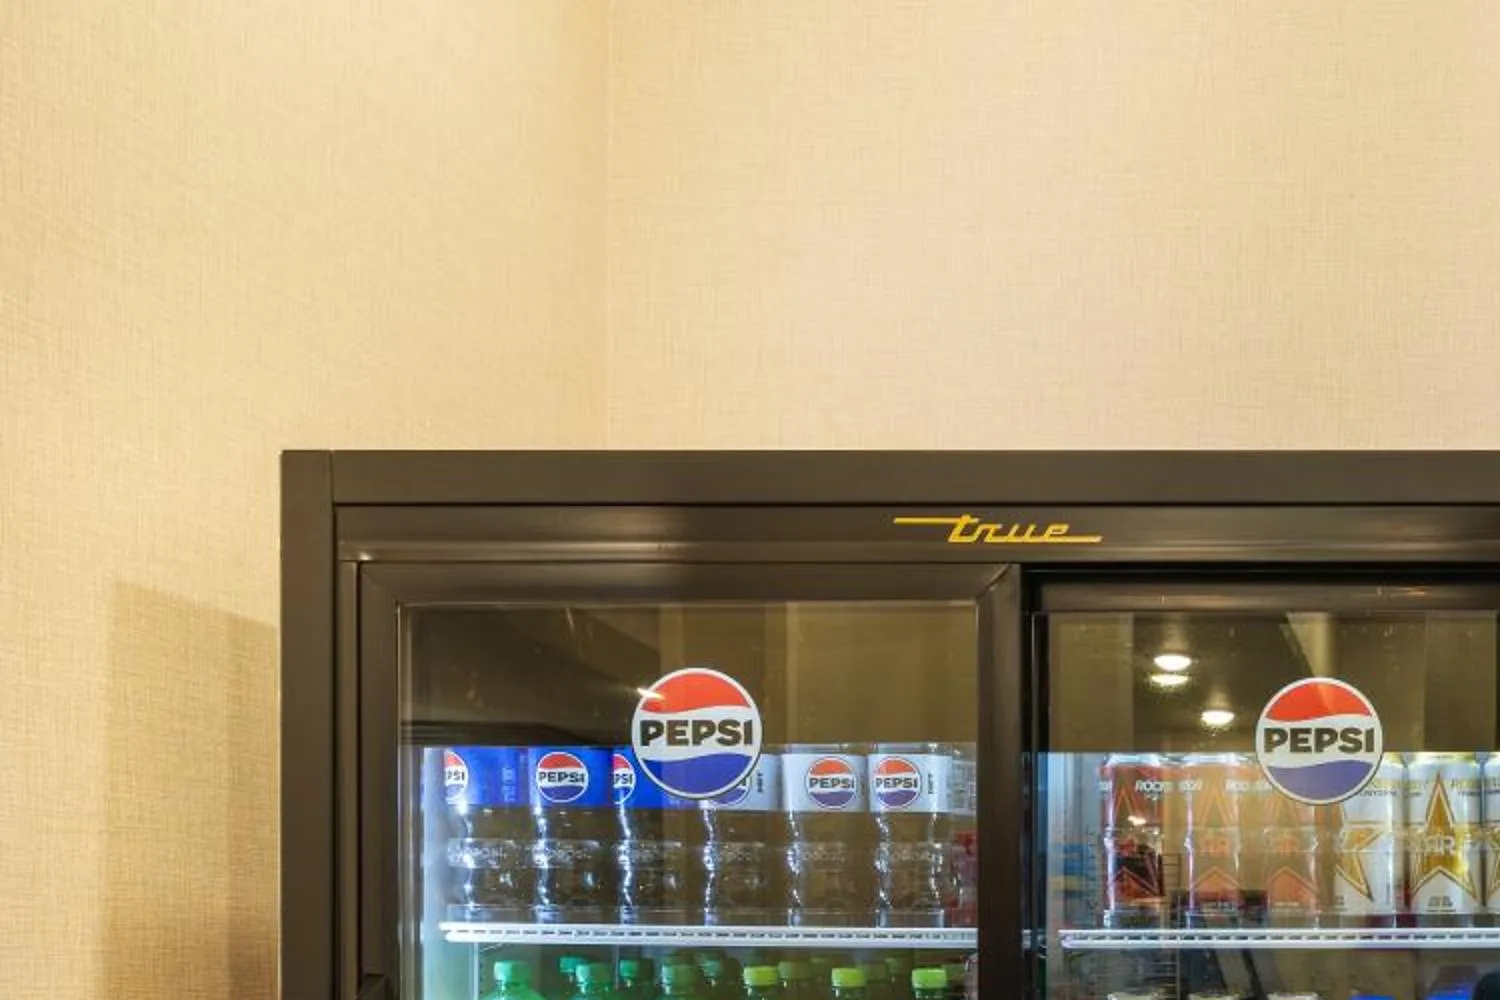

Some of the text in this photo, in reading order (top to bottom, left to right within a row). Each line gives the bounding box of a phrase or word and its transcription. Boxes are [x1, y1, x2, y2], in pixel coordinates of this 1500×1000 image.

[893, 514, 1103, 543] true
[640, 719, 754, 747] PEPSI
[1263, 727, 1376, 755] PEPSI
[446, 771, 466, 782] PSI
[539, 771, 586, 783] PEPSI
[613, 773, 633, 785] PSI
[809, 777, 855, 789] PEPSI
[875, 777, 919, 789] PEPSI
